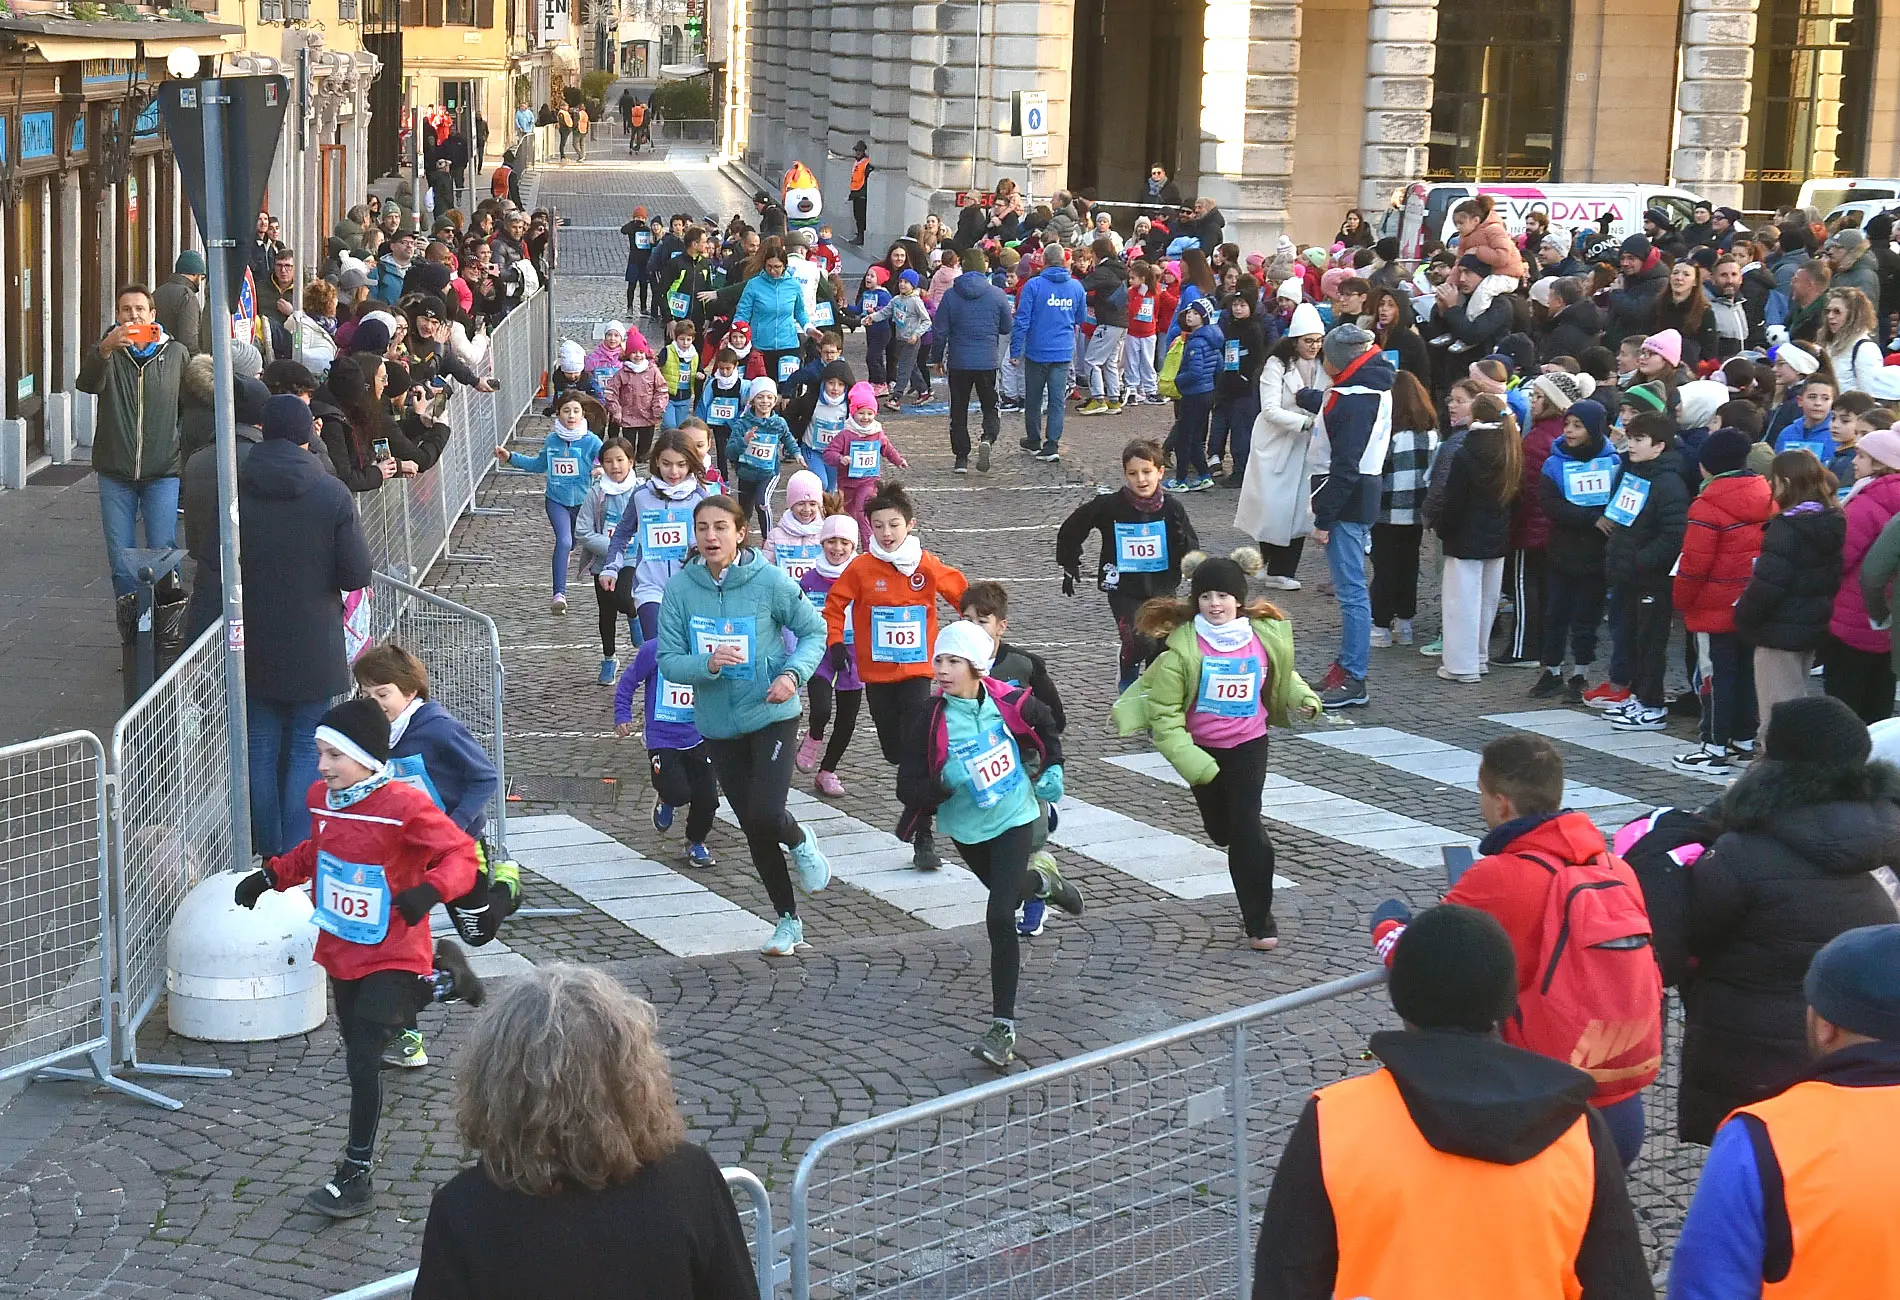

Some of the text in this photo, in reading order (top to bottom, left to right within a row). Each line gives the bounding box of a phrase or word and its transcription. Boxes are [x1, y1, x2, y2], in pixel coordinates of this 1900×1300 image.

[22, 119, 51, 151] ARMACIA
[1047, 293, 1073, 307] dona
[715, 409, 731, 418] 103
[751, 446, 770, 458] 103
[858, 456, 874, 466] 103
[554, 463, 574, 474] 103
[1576, 478, 1603, 492] 111
[1620, 494, 1637, 511] 111
[654, 530, 681, 545] 103
[1128, 543, 1156, 557] 103
[885, 630, 915, 646] 103
[1216, 683, 1248, 699] 103
[979, 754, 1010, 783] 103
[331, 891, 369, 918] 103
